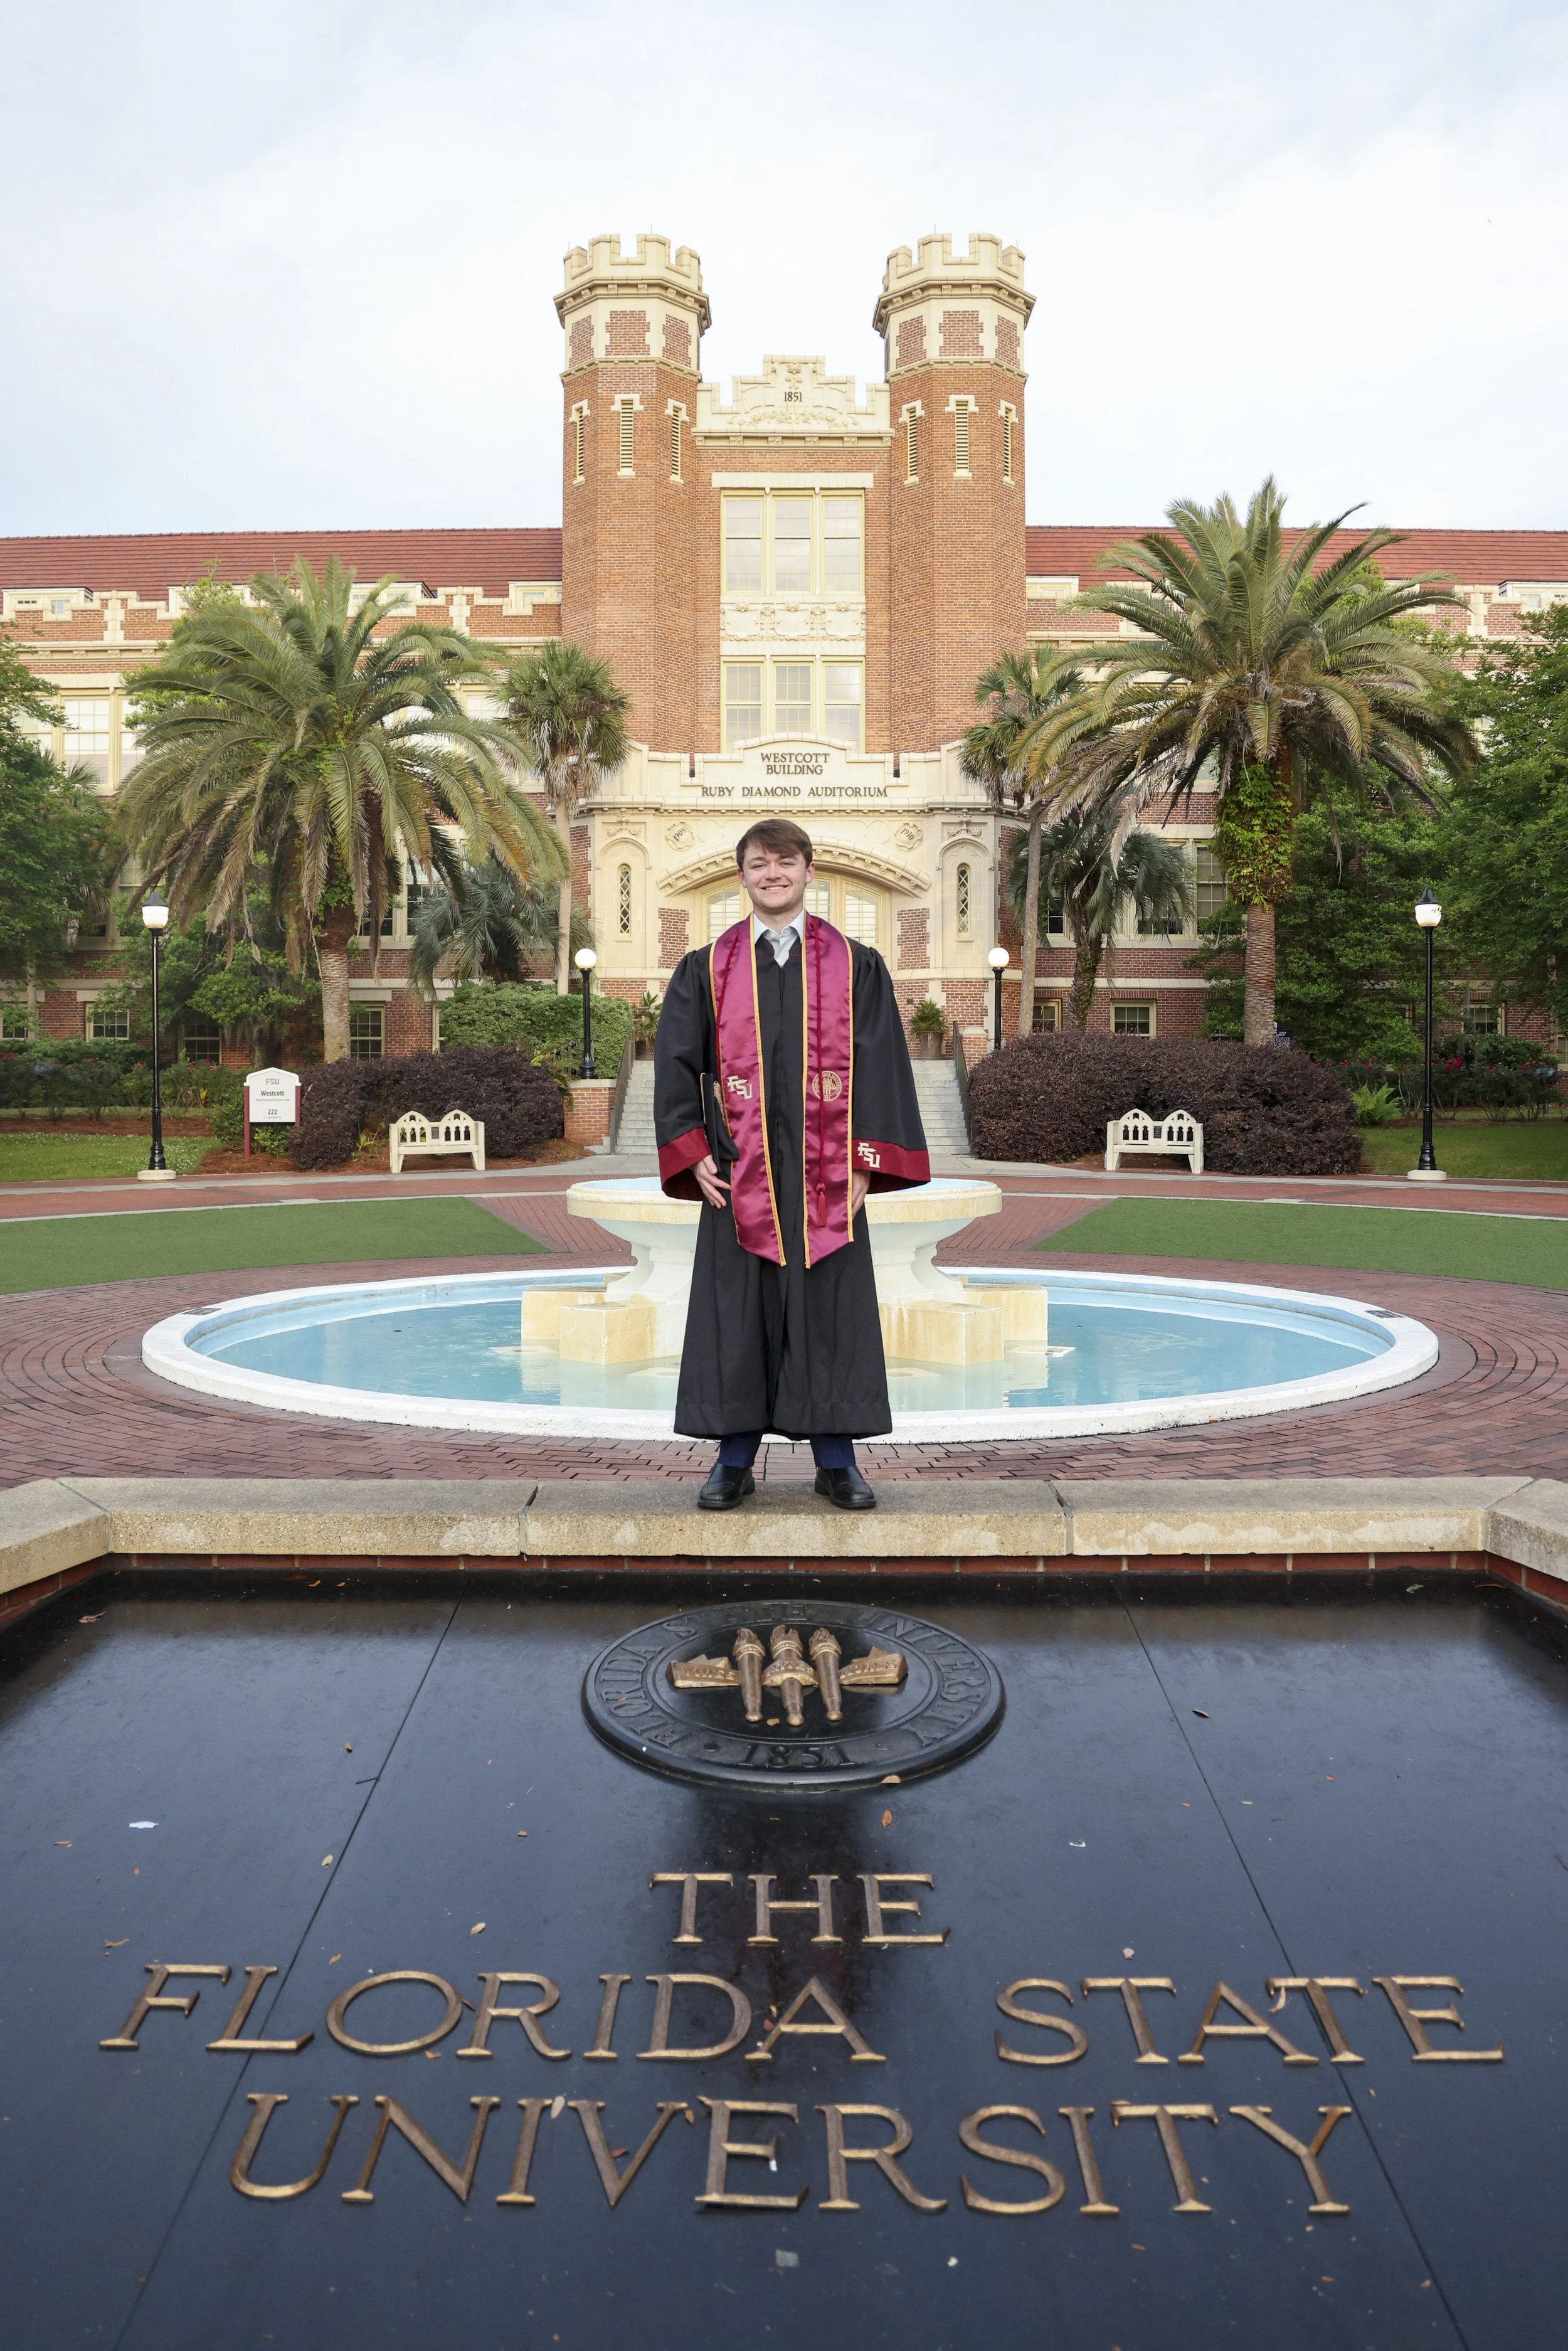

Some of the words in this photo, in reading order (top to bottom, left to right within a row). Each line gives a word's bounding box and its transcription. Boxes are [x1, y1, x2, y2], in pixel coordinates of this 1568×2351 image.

[784, 391, 803, 402] 1851
[760, 752, 830, 763] WESTCOTT
[766, 764, 824, 775] BUILDING
[701, 786, 735, 797] RUBY
[741, 786, 801, 797] DIAMOND
[807, 786, 888, 797] AUDITORIUM
[673, 827, 687, 842] 1905
[900, 828, 914, 841] 1910
[726, 1075, 753, 1100] FSU
[857, 1142, 881, 1169] FSU
[600, 1645, 694, 1749] FLORIDA
[737, 1744, 856, 1769] 1851
[649, 1872, 951, 1946] THE
[98, 1963, 886, 2061] FLORIDA
[993, 1975, 1504, 2066] STATE
[228, 2093, 1352, 2214] UNIVERSITY
